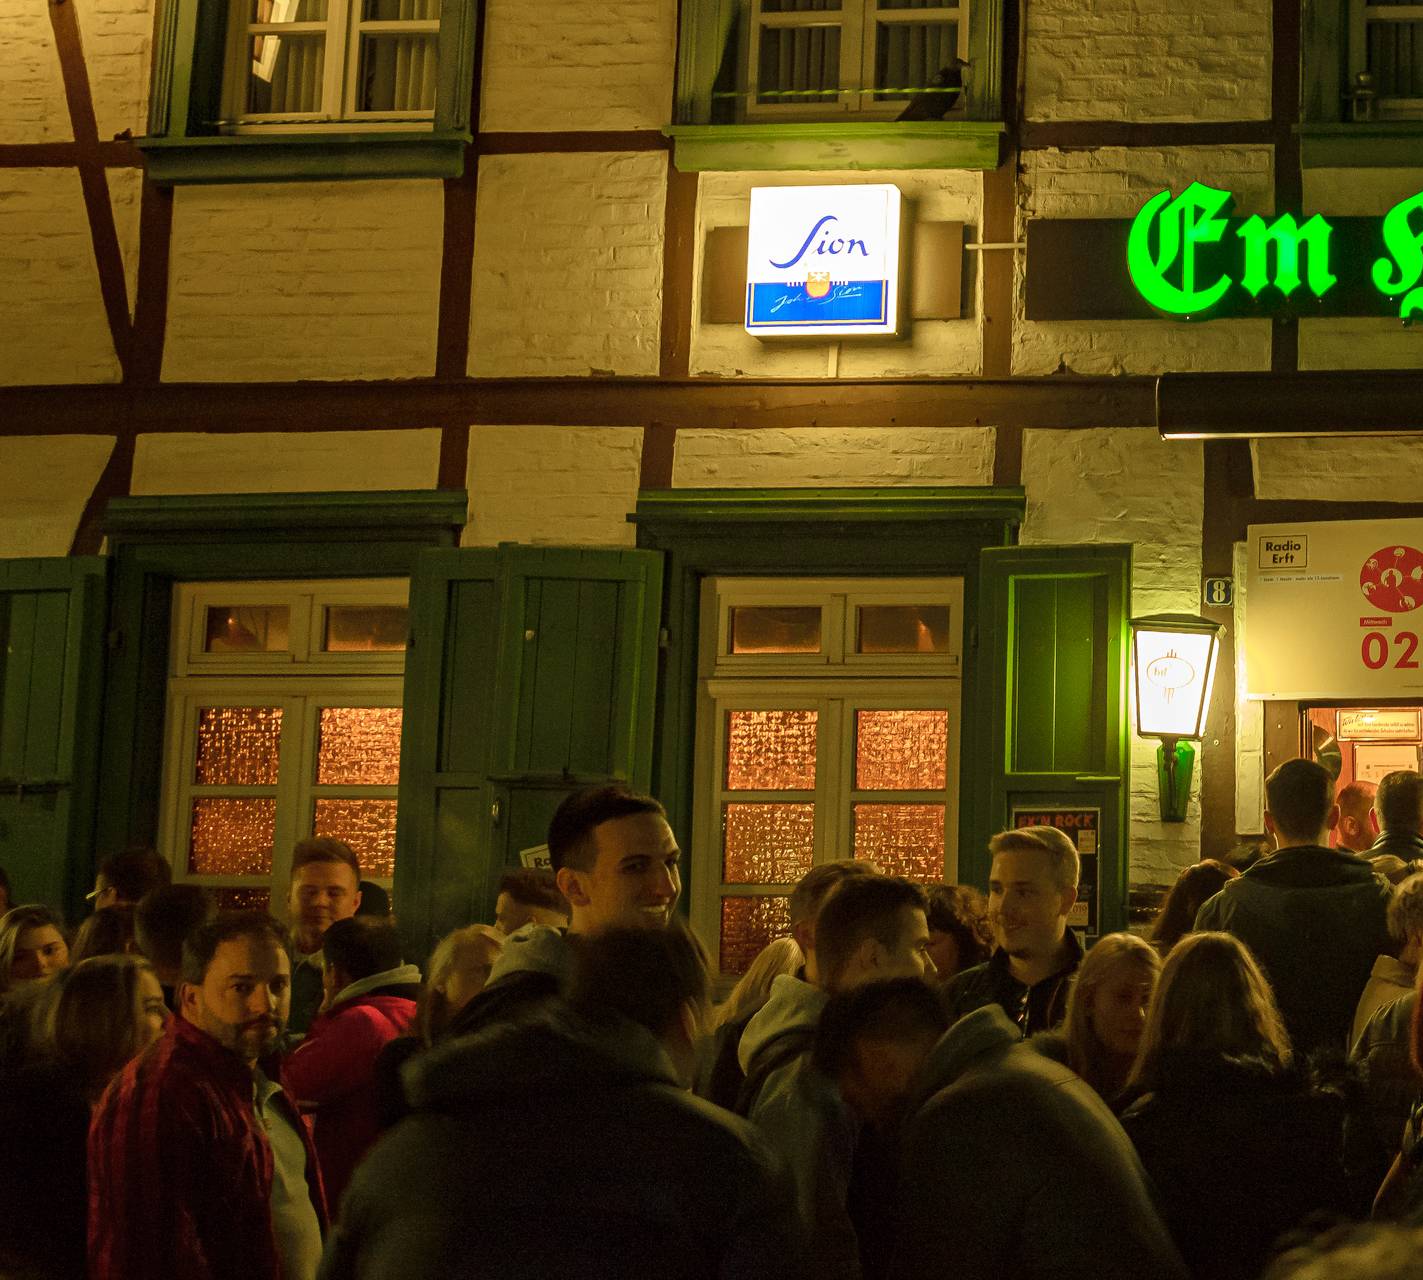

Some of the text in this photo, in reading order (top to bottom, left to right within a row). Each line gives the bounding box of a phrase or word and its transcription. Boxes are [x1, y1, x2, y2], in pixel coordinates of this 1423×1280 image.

[768, 215, 869, 269] Sion
[1126, 180, 1337, 314] Em
[1265, 540, 1301, 552] Radio
[1272, 553, 1295, 564] Erft
[1212, 580, 1226, 603] 8
[1055, 814, 1094, 827] ROCK
[1072, 904, 1088, 913] 019
